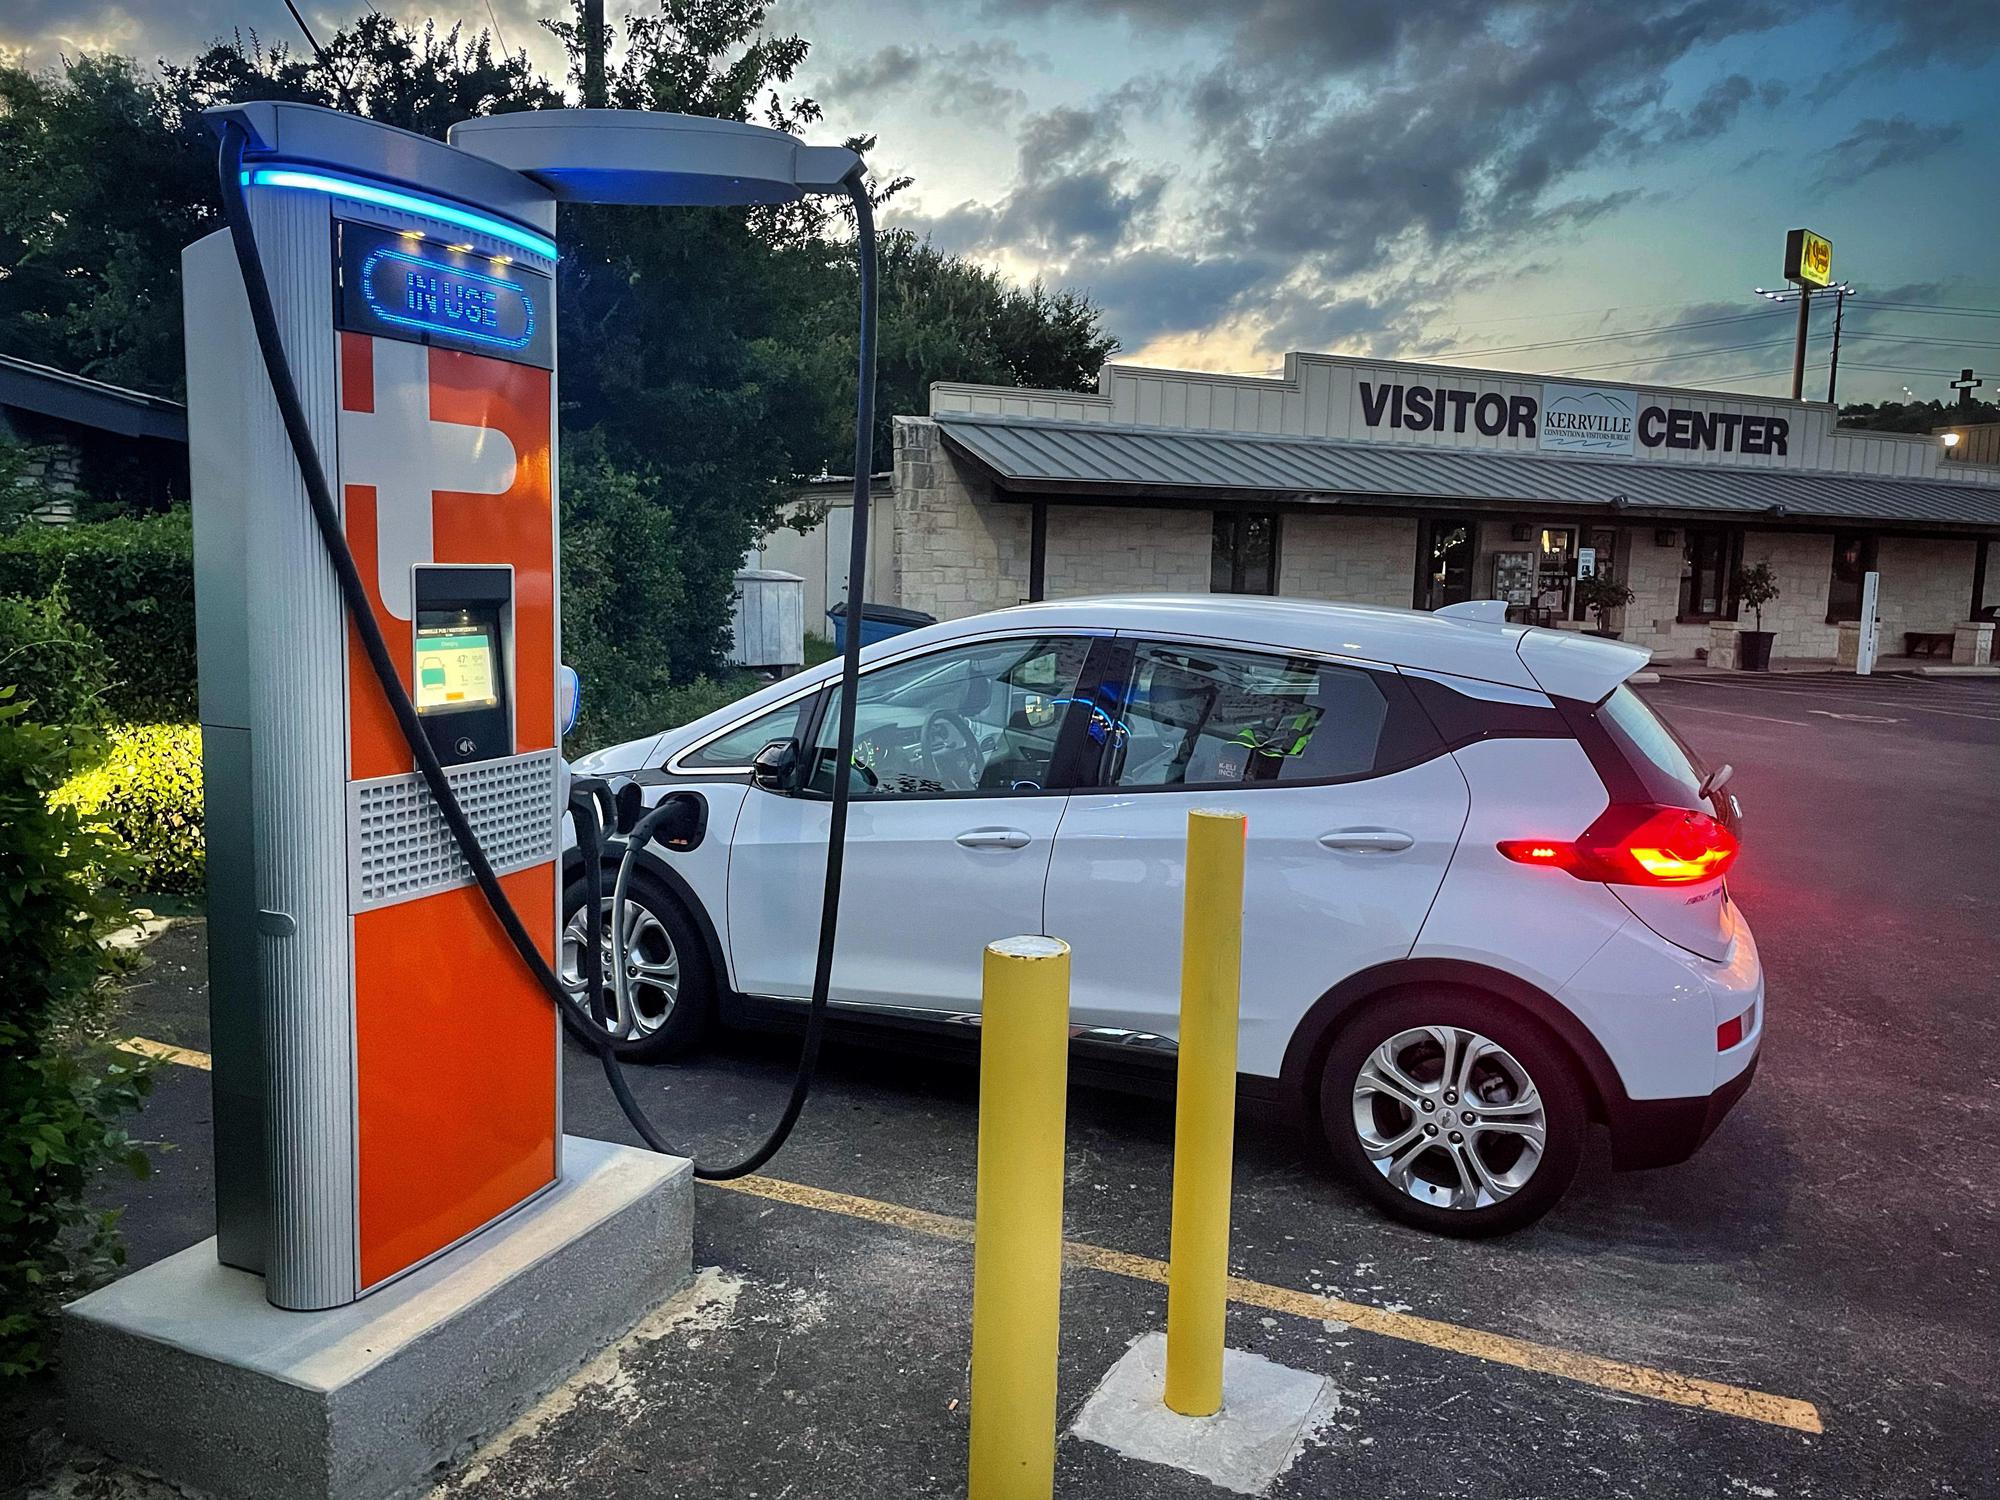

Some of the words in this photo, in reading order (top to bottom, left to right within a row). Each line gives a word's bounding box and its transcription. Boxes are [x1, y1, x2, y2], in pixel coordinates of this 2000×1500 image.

[407, 273, 437, 314] IN
[444, 281, 497, 327] USE
[1359, 381, 1538, 438] VISITOR
[1637, 405, 1790, 456] CENTER
[1544, 428, 1581, 439] CONVENTION
[1586, 432, 1610, 440] VISITORS
[1545, 411, 1632, 433] KERRVILLE
